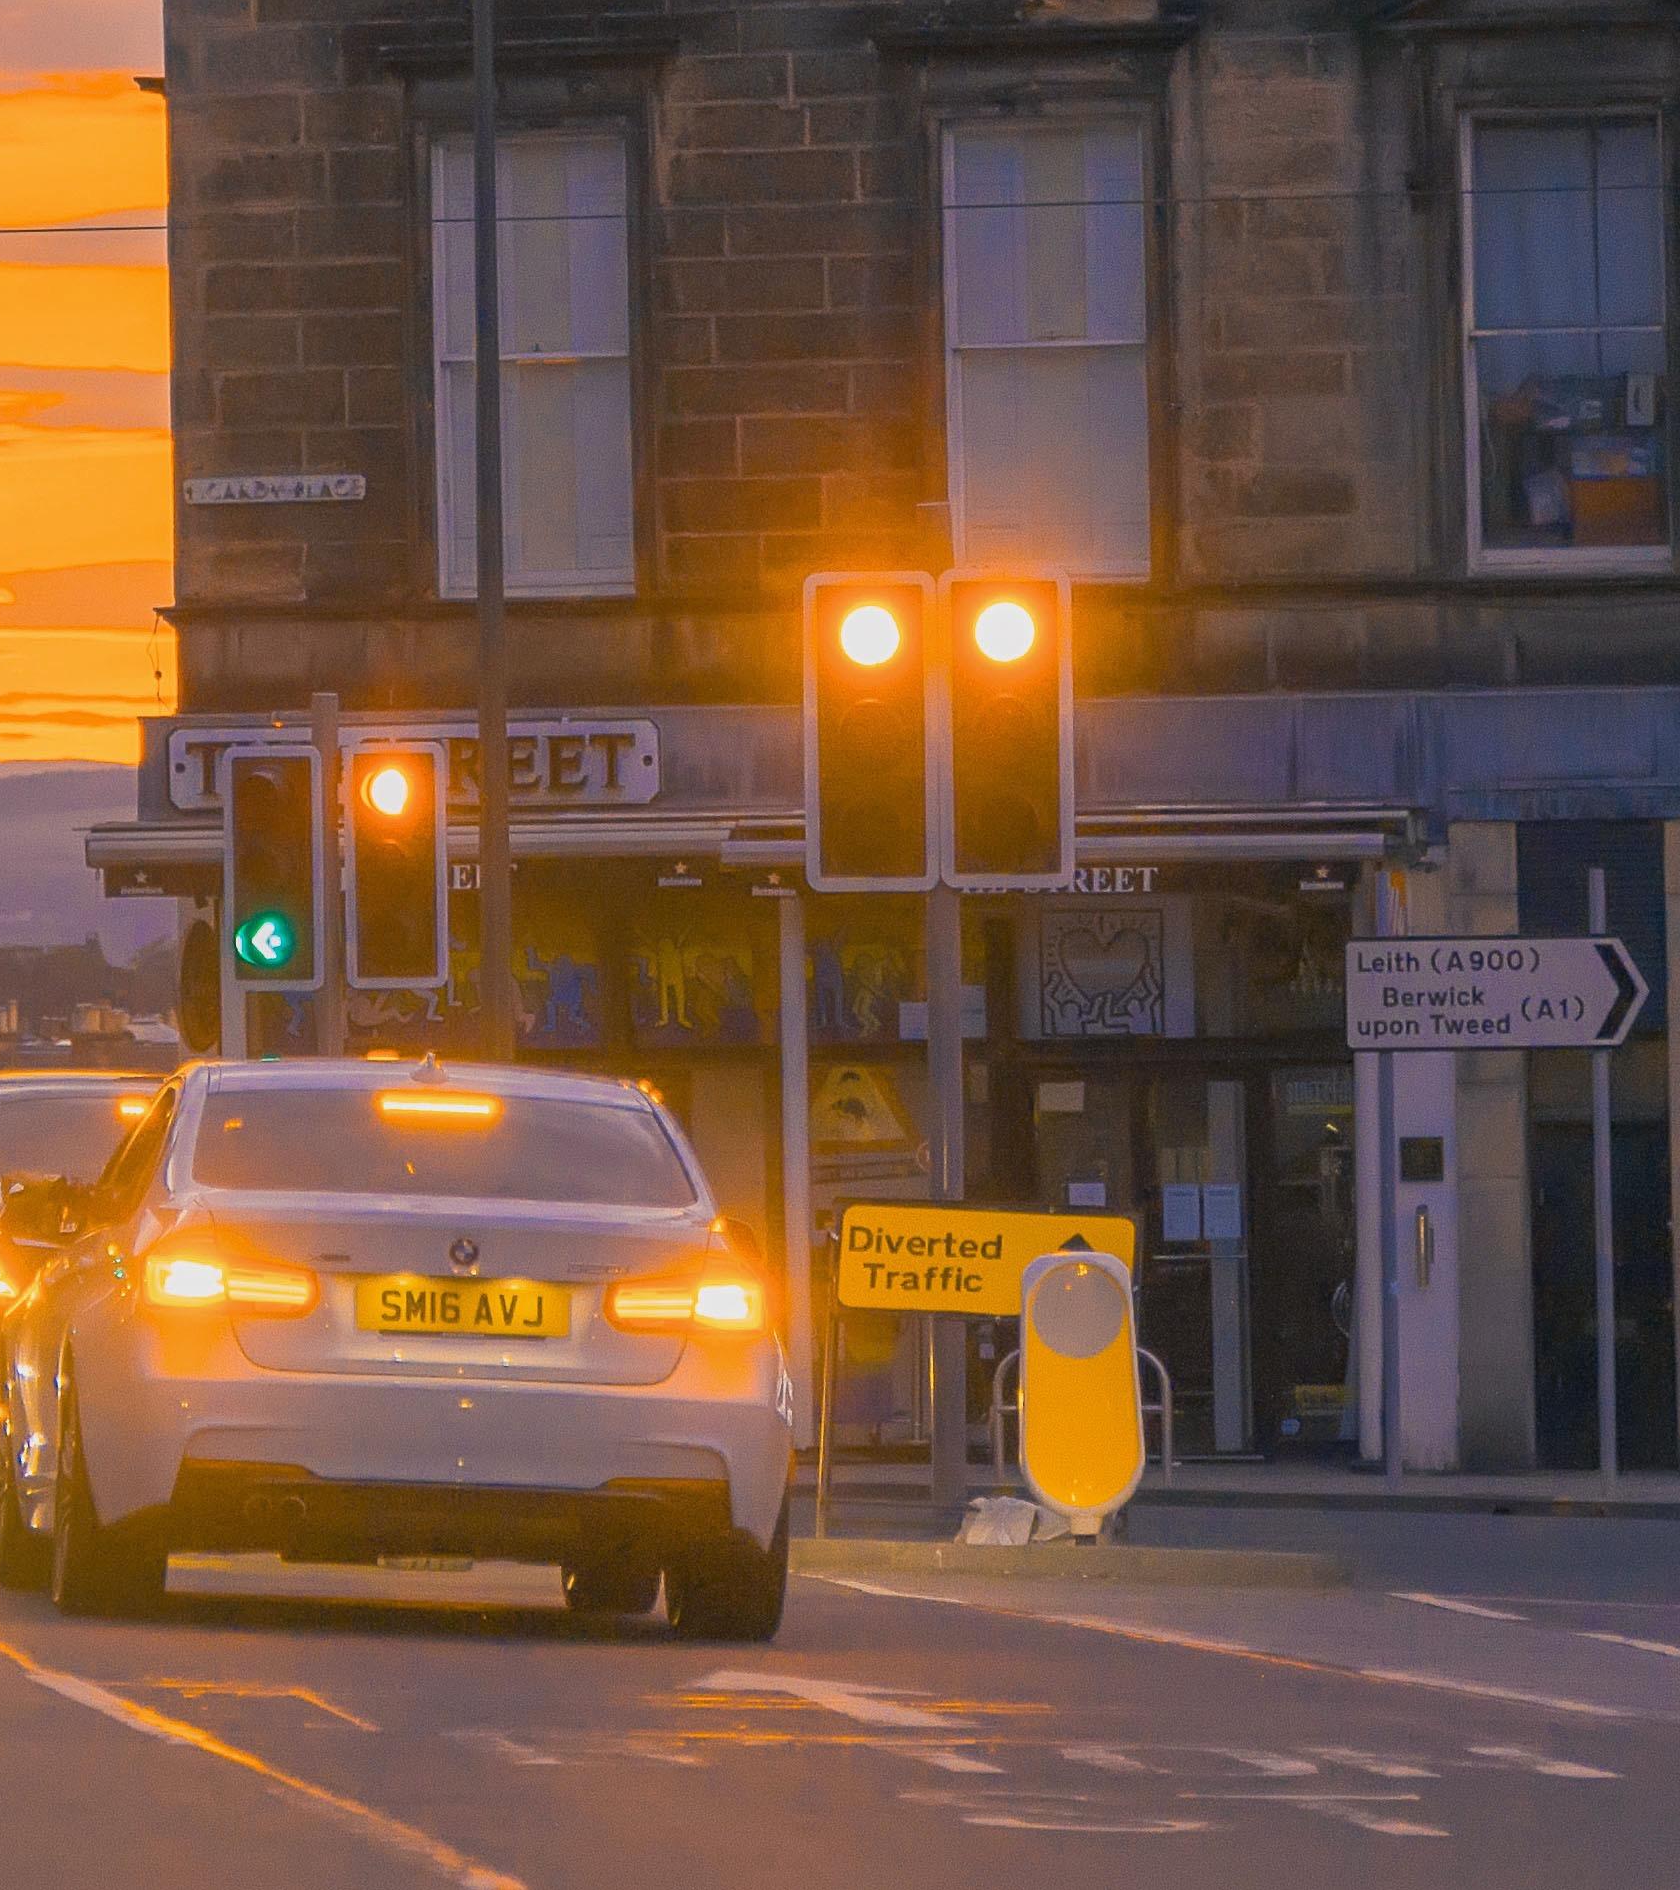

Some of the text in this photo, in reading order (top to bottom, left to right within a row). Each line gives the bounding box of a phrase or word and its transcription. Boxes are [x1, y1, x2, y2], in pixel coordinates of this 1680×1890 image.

[1357, 951, 1420, 973] Leith
[1382, 986, 1485, 1007] Berwick
[1357, 1013, 1511, 1040] upon Tweed
[848, 1225, 1003, 1260] Diverted
[863, 1263, 983, 1293] Traffic
[380, 1290, 544, 1328] SM16 AVJ
